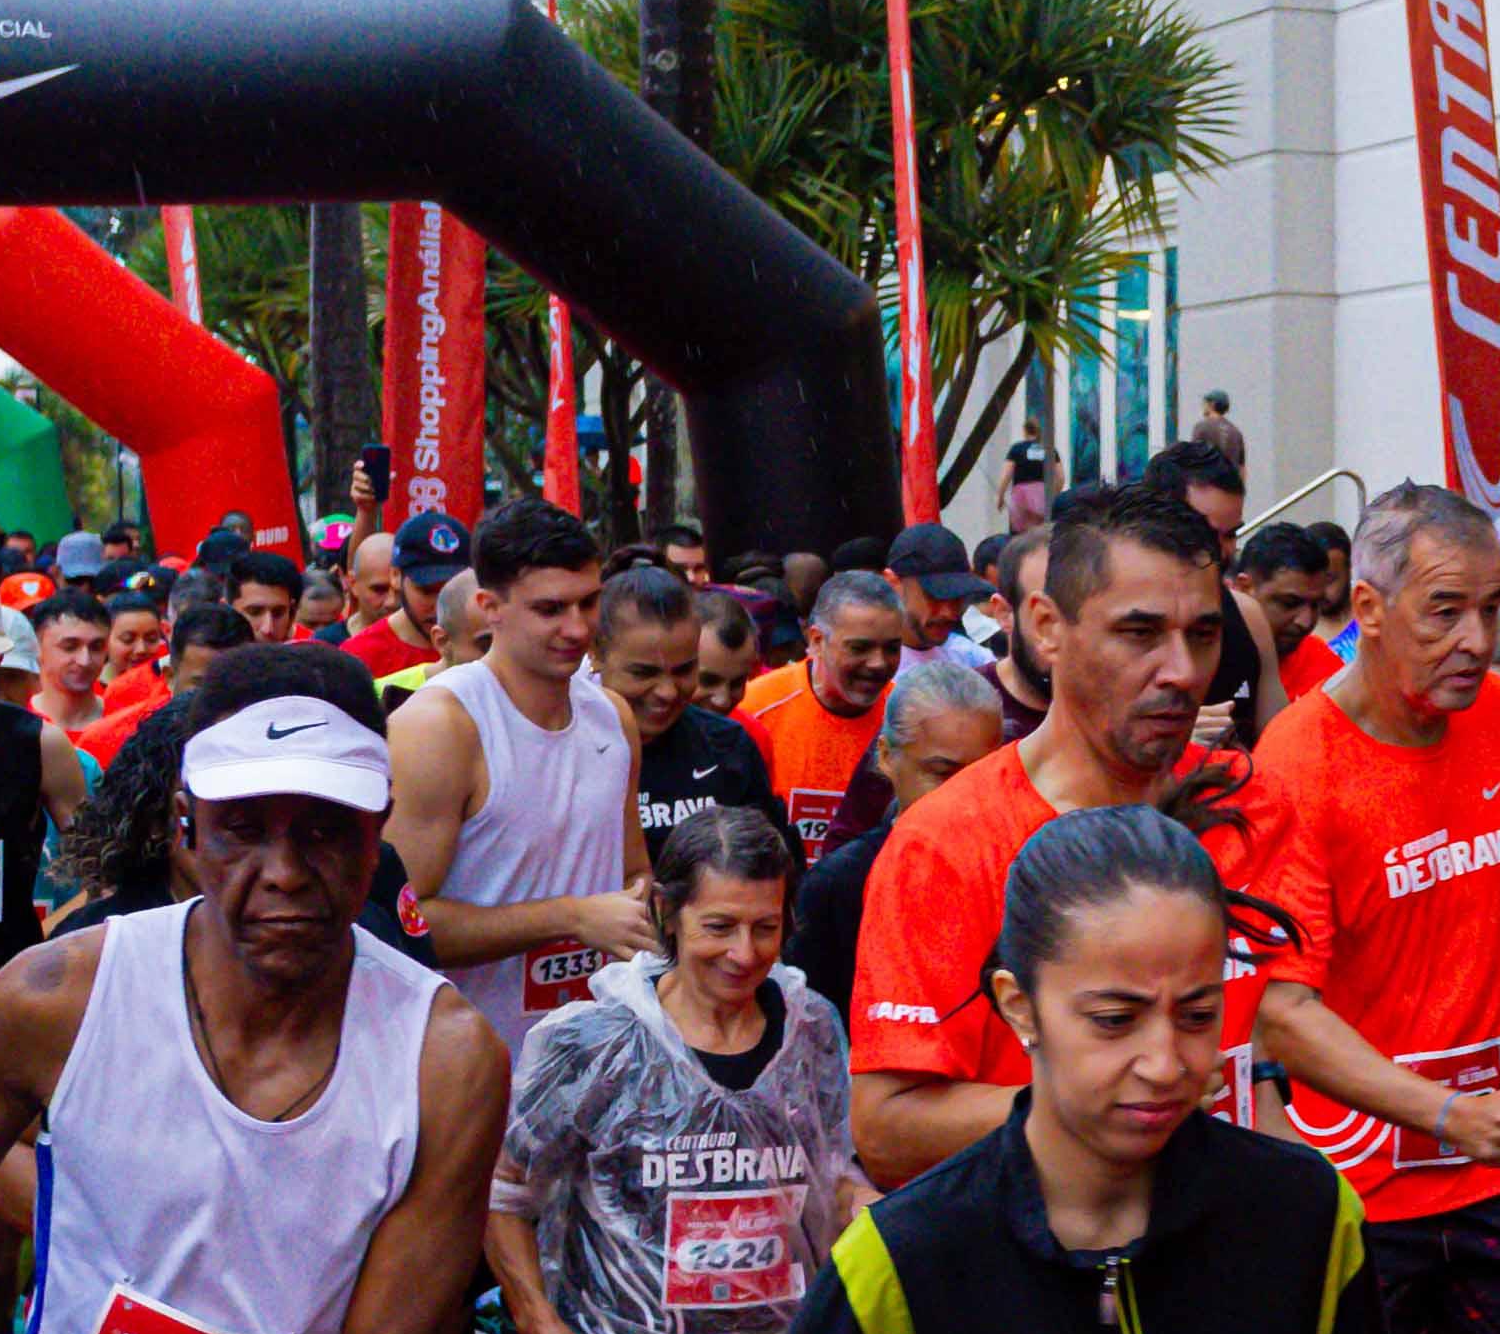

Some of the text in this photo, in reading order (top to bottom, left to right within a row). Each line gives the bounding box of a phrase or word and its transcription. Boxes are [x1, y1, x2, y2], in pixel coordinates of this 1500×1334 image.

[638, 796, 718, 829] BRAVA
[802, 821, 829, 838] 19
[539, 950, 597, 982] 1333
[642, 1146, 806, 1188] DESBRAVA
